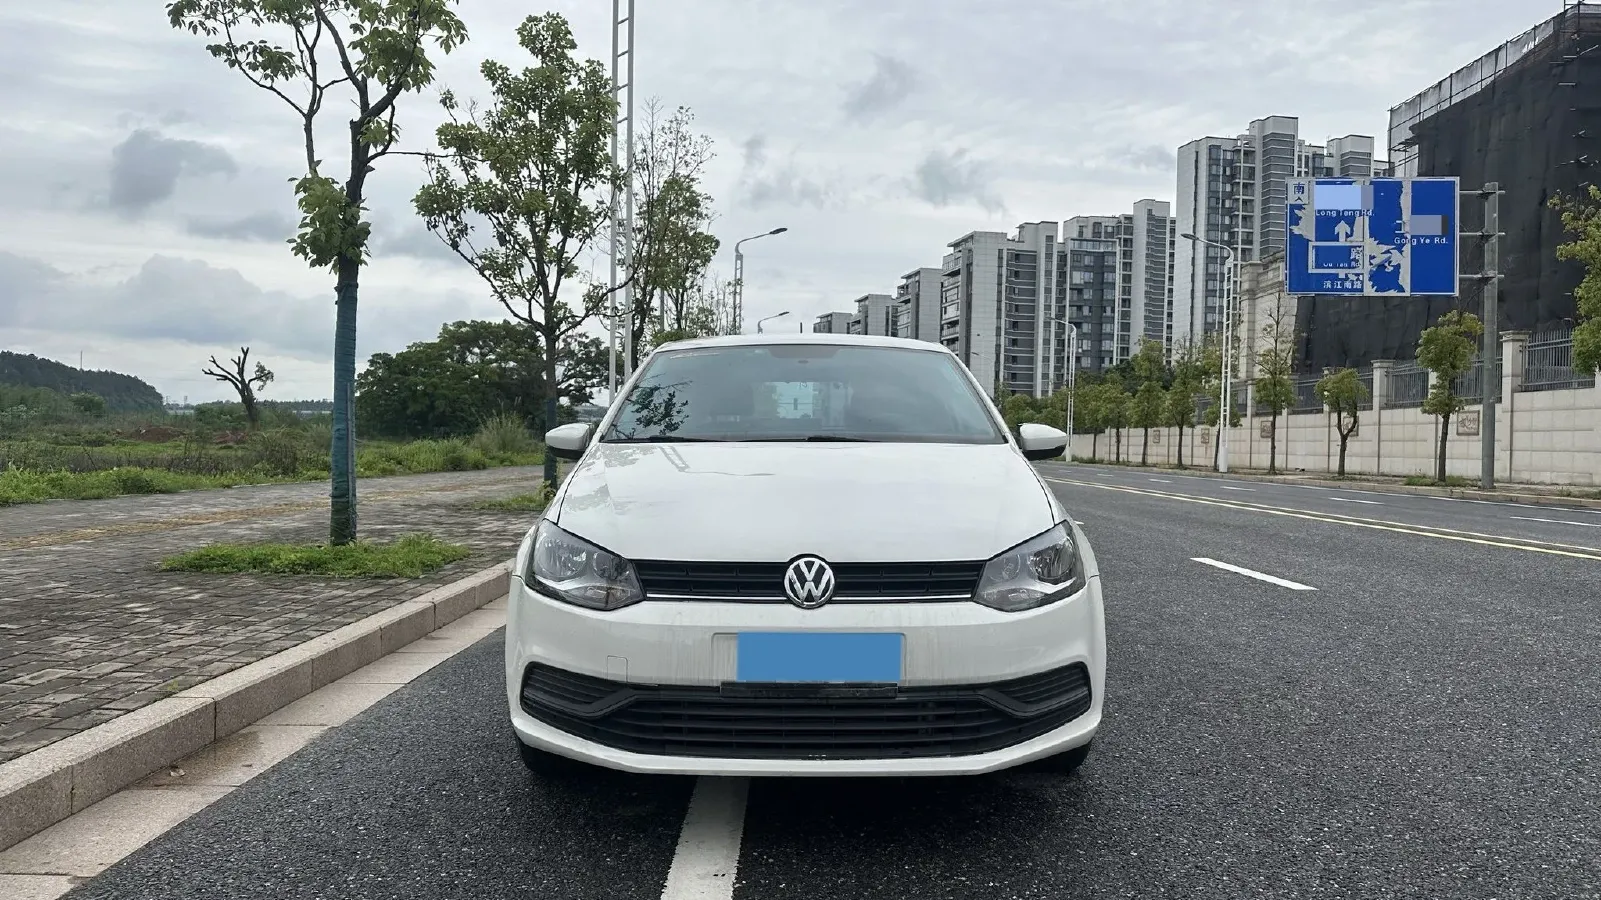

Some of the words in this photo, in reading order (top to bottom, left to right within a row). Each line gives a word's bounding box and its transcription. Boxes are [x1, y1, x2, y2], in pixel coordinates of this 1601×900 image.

[1293, 182, 1305, 195] 南
[1315, 209, 1337, 217] Long
[1394, 236, 1417, 246] Gong
[1323, 280, 1362, 289] 滨江南路
[784, 557, 835, 608] VW
